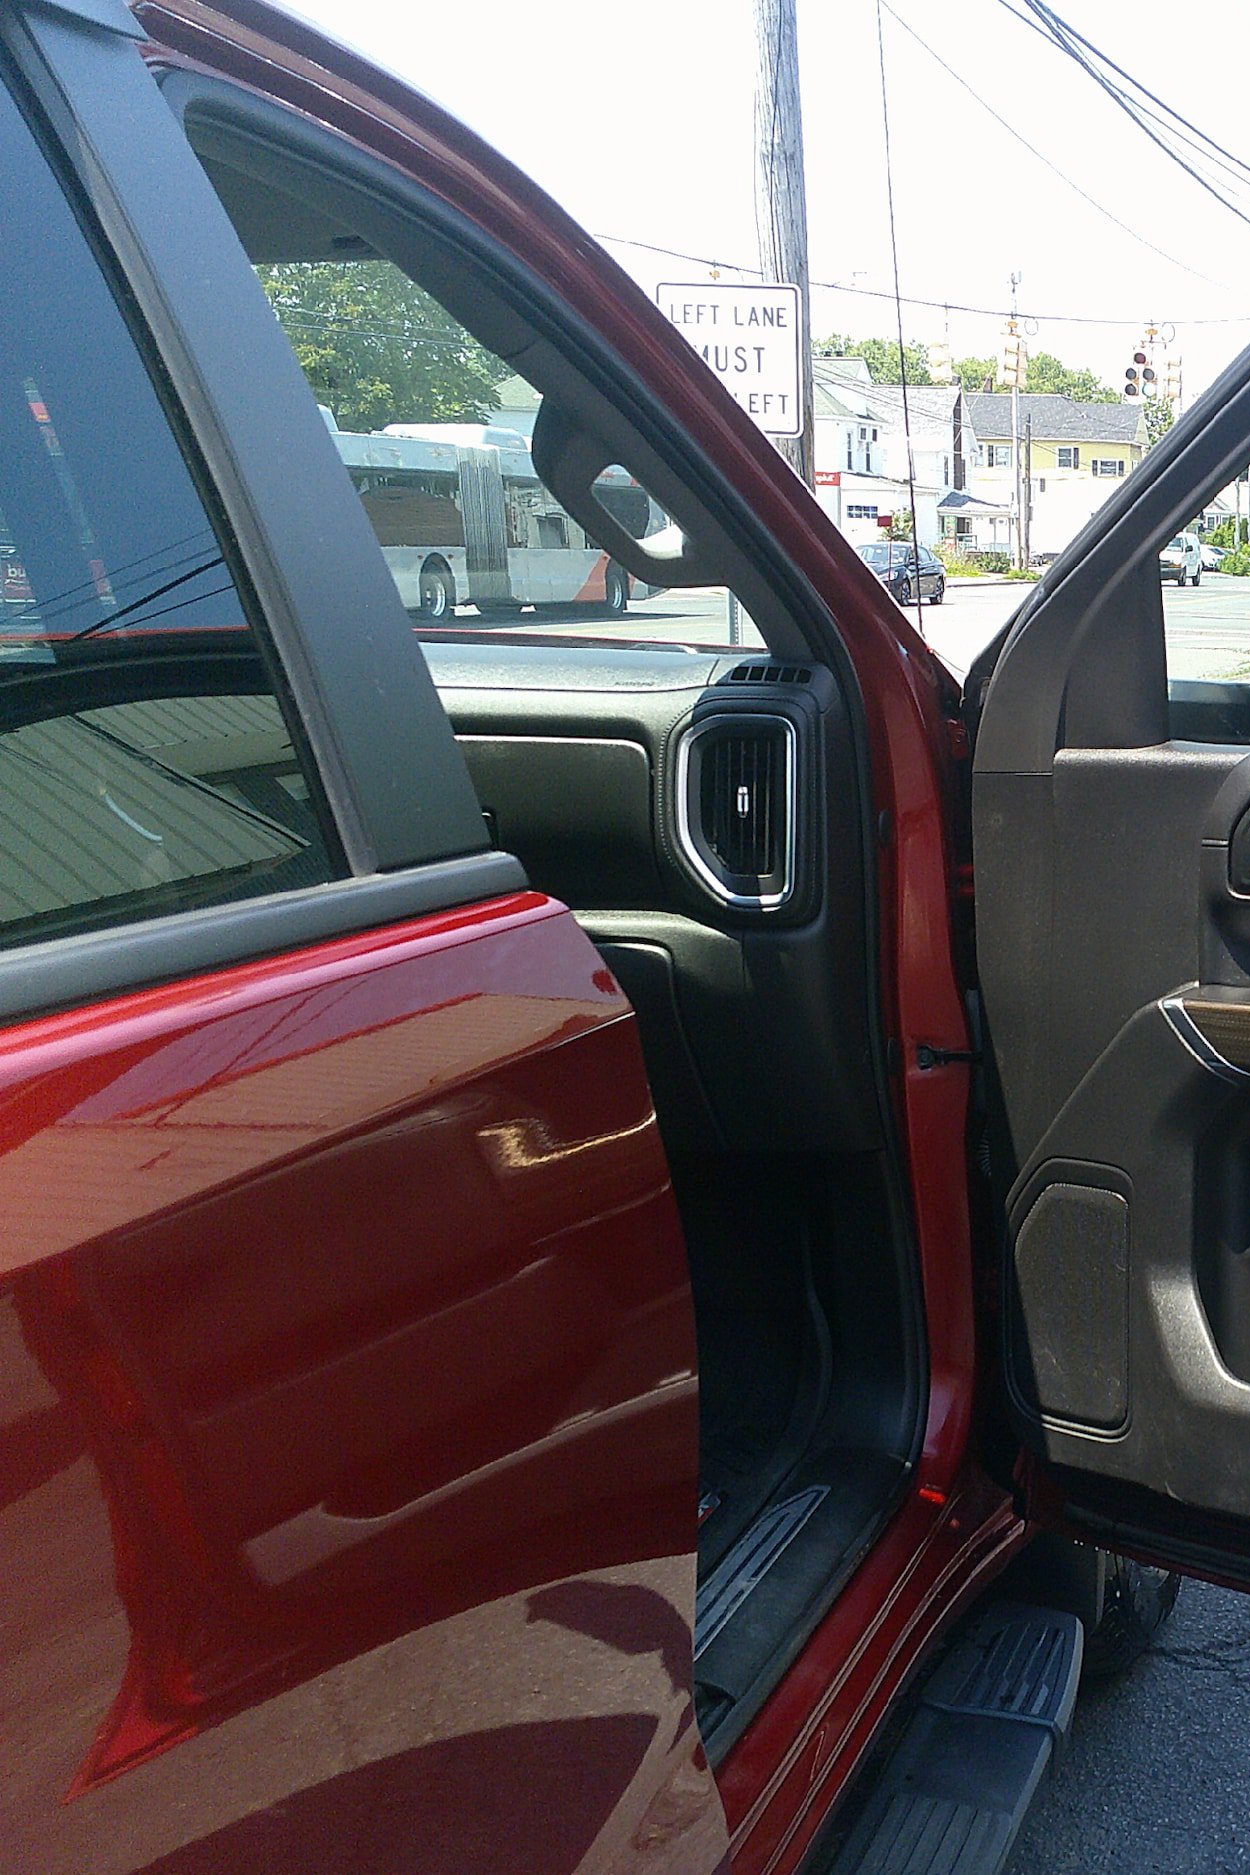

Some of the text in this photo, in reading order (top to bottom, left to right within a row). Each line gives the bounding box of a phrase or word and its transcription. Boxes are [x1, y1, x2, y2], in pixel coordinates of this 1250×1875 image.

[670, 304, 788, 328] LEFT LANE
[734, 393, 789, 415] EFT
